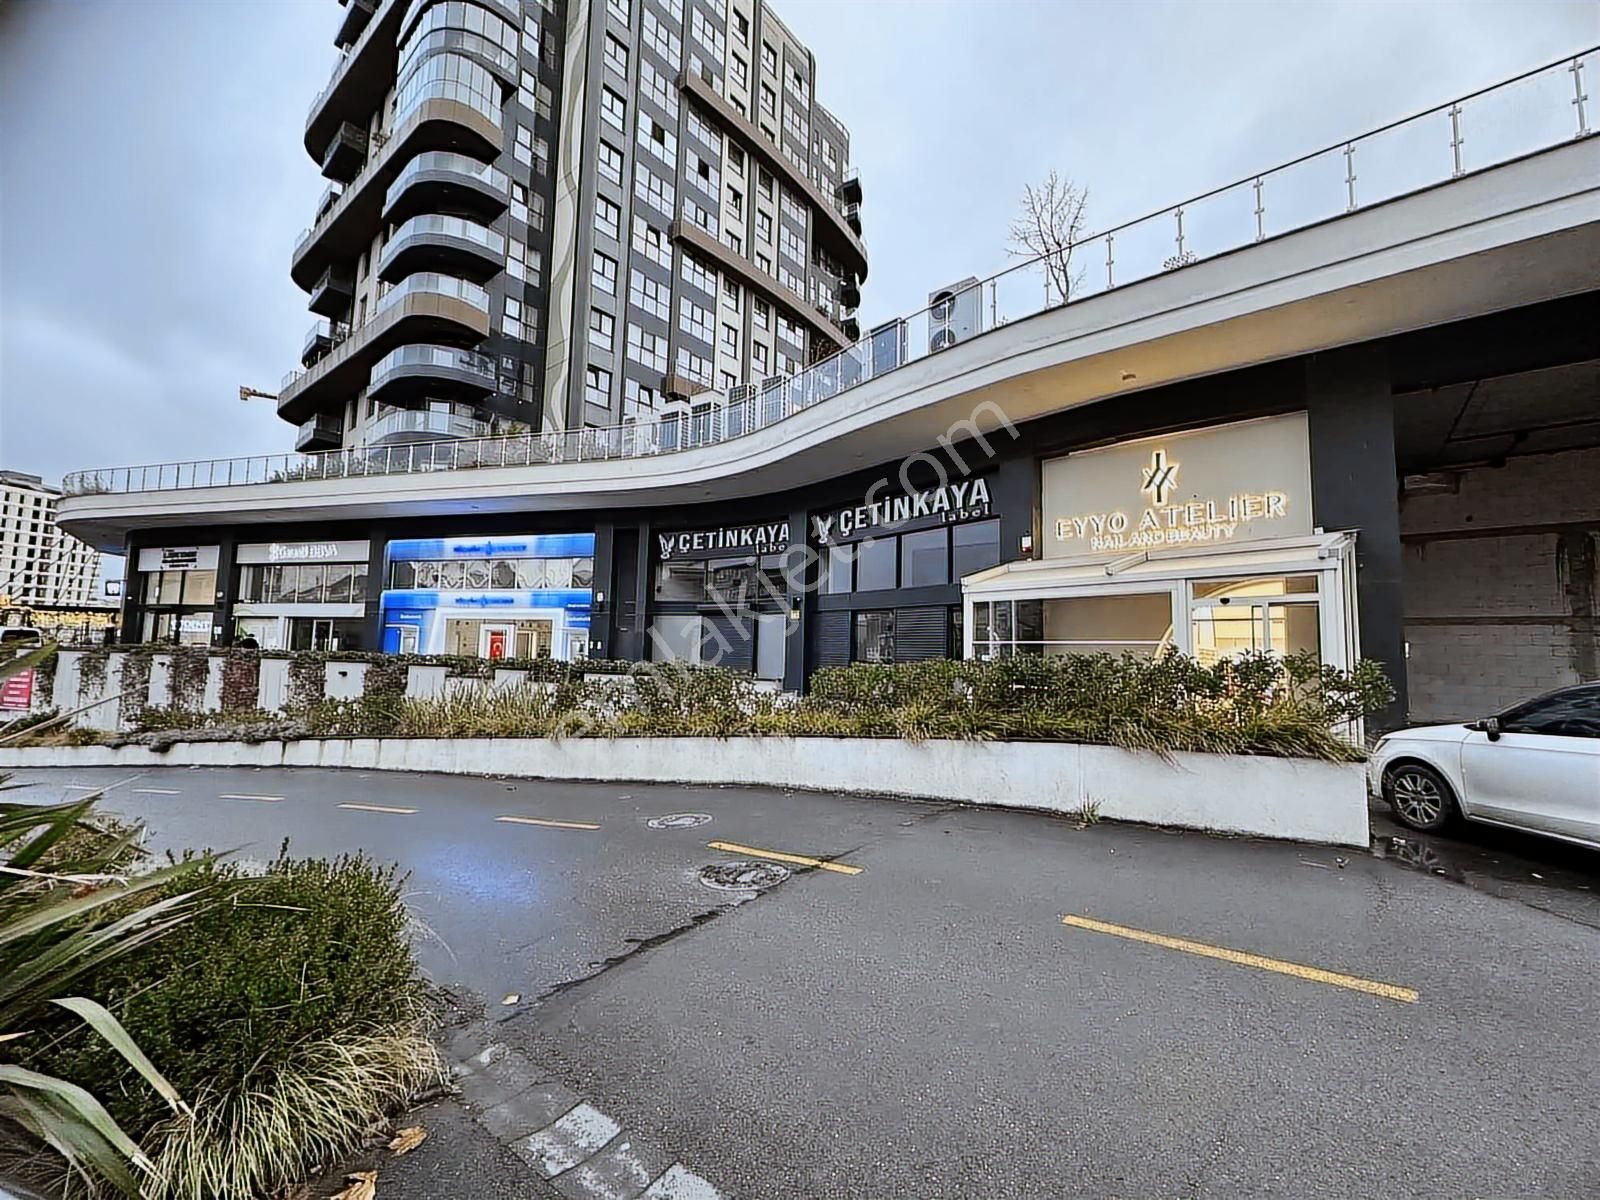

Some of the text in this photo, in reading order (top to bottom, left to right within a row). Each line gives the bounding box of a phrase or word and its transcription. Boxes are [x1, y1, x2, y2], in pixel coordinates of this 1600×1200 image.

[840, 478, 990, 537] ÇETİNKAYA
[941, 503, 990, 523] label
[1056, 493, 1286, 541] EYYO ATELIER
[678, 523, 790, 554] ÇETİNKAYA
[1165, 523, 1238, 544] BEAUTY
[755, 543, 786, 554] labe
